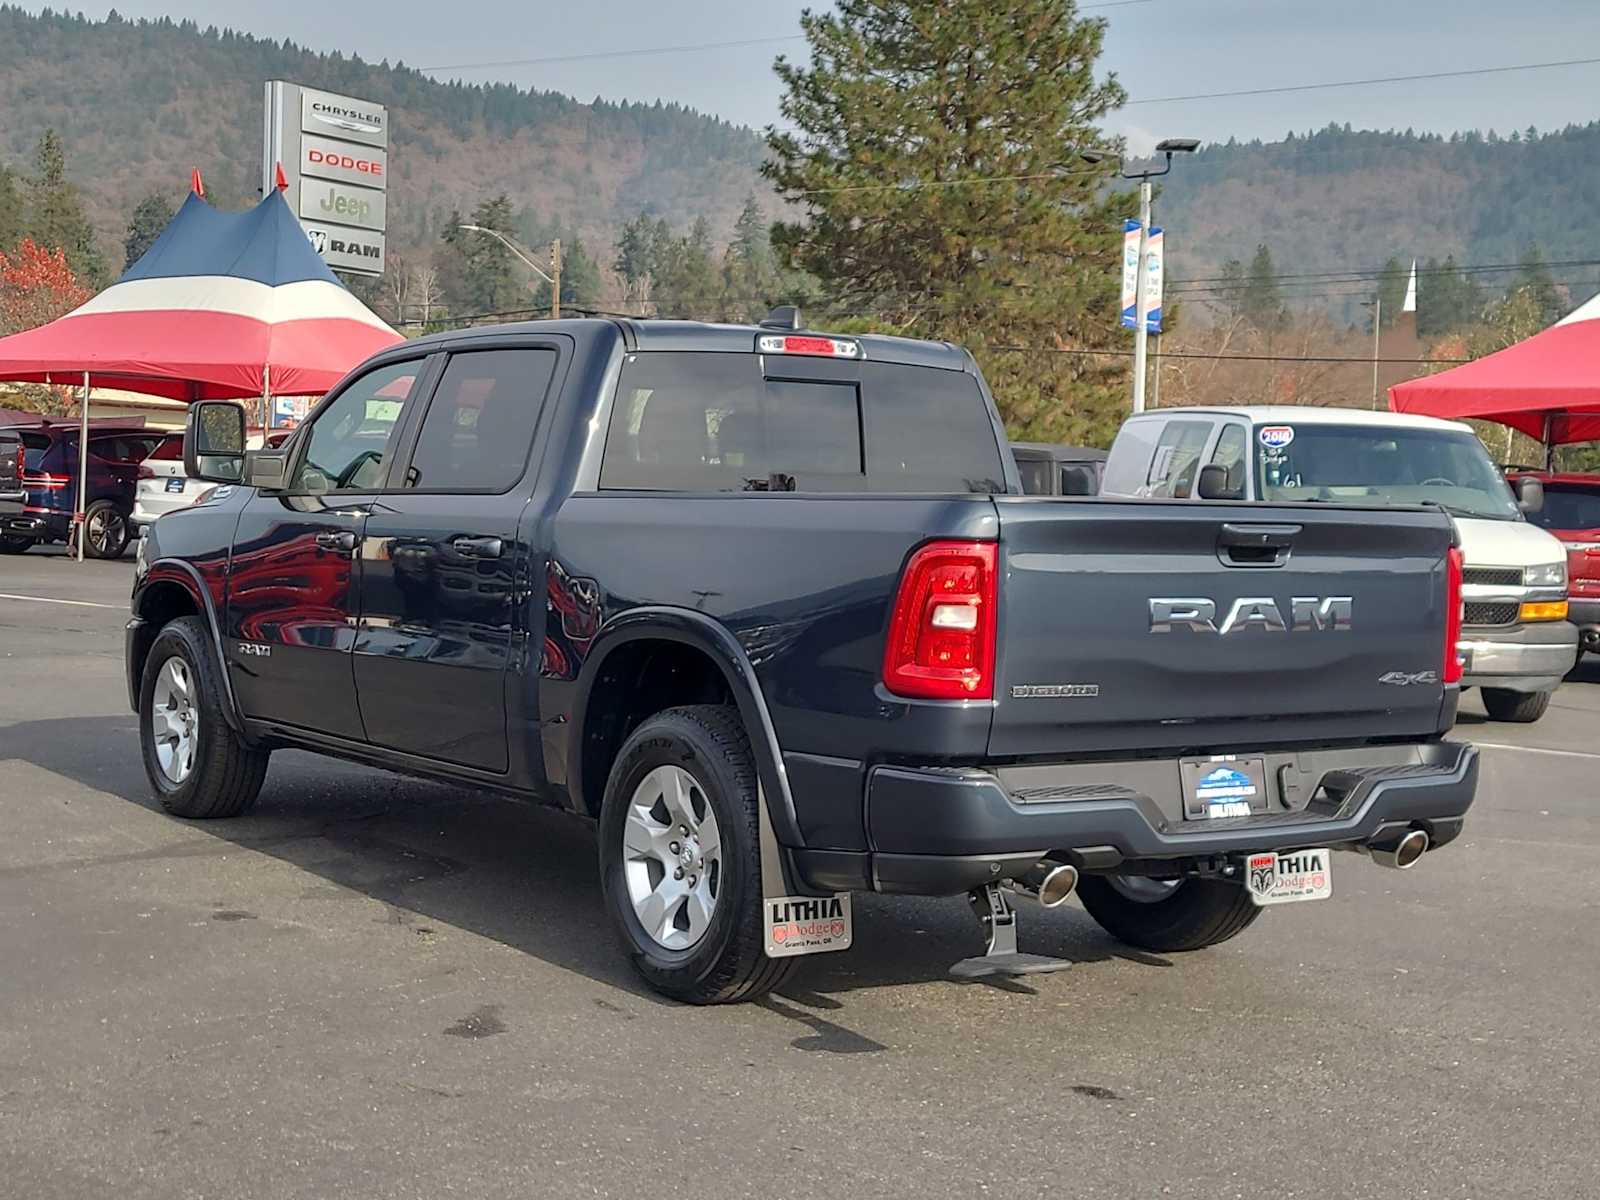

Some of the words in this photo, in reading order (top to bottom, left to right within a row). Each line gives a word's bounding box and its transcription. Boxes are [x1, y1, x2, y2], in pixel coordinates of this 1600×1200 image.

[312, 103, 382, 124] CHRYSLER
[309, 150, 383, 176] DODGE
[320, 188, 369, 222] Jeep
[331, 240, 380, 258] RAM
[1147, 596, 1353, 635] RAM
[238, 642, 271, 657] RAM
[1278, 855, 1323, 874] THIA
[773, 899, 844, 923] LITHIA
[786, 922, 830, 937] Dodge
